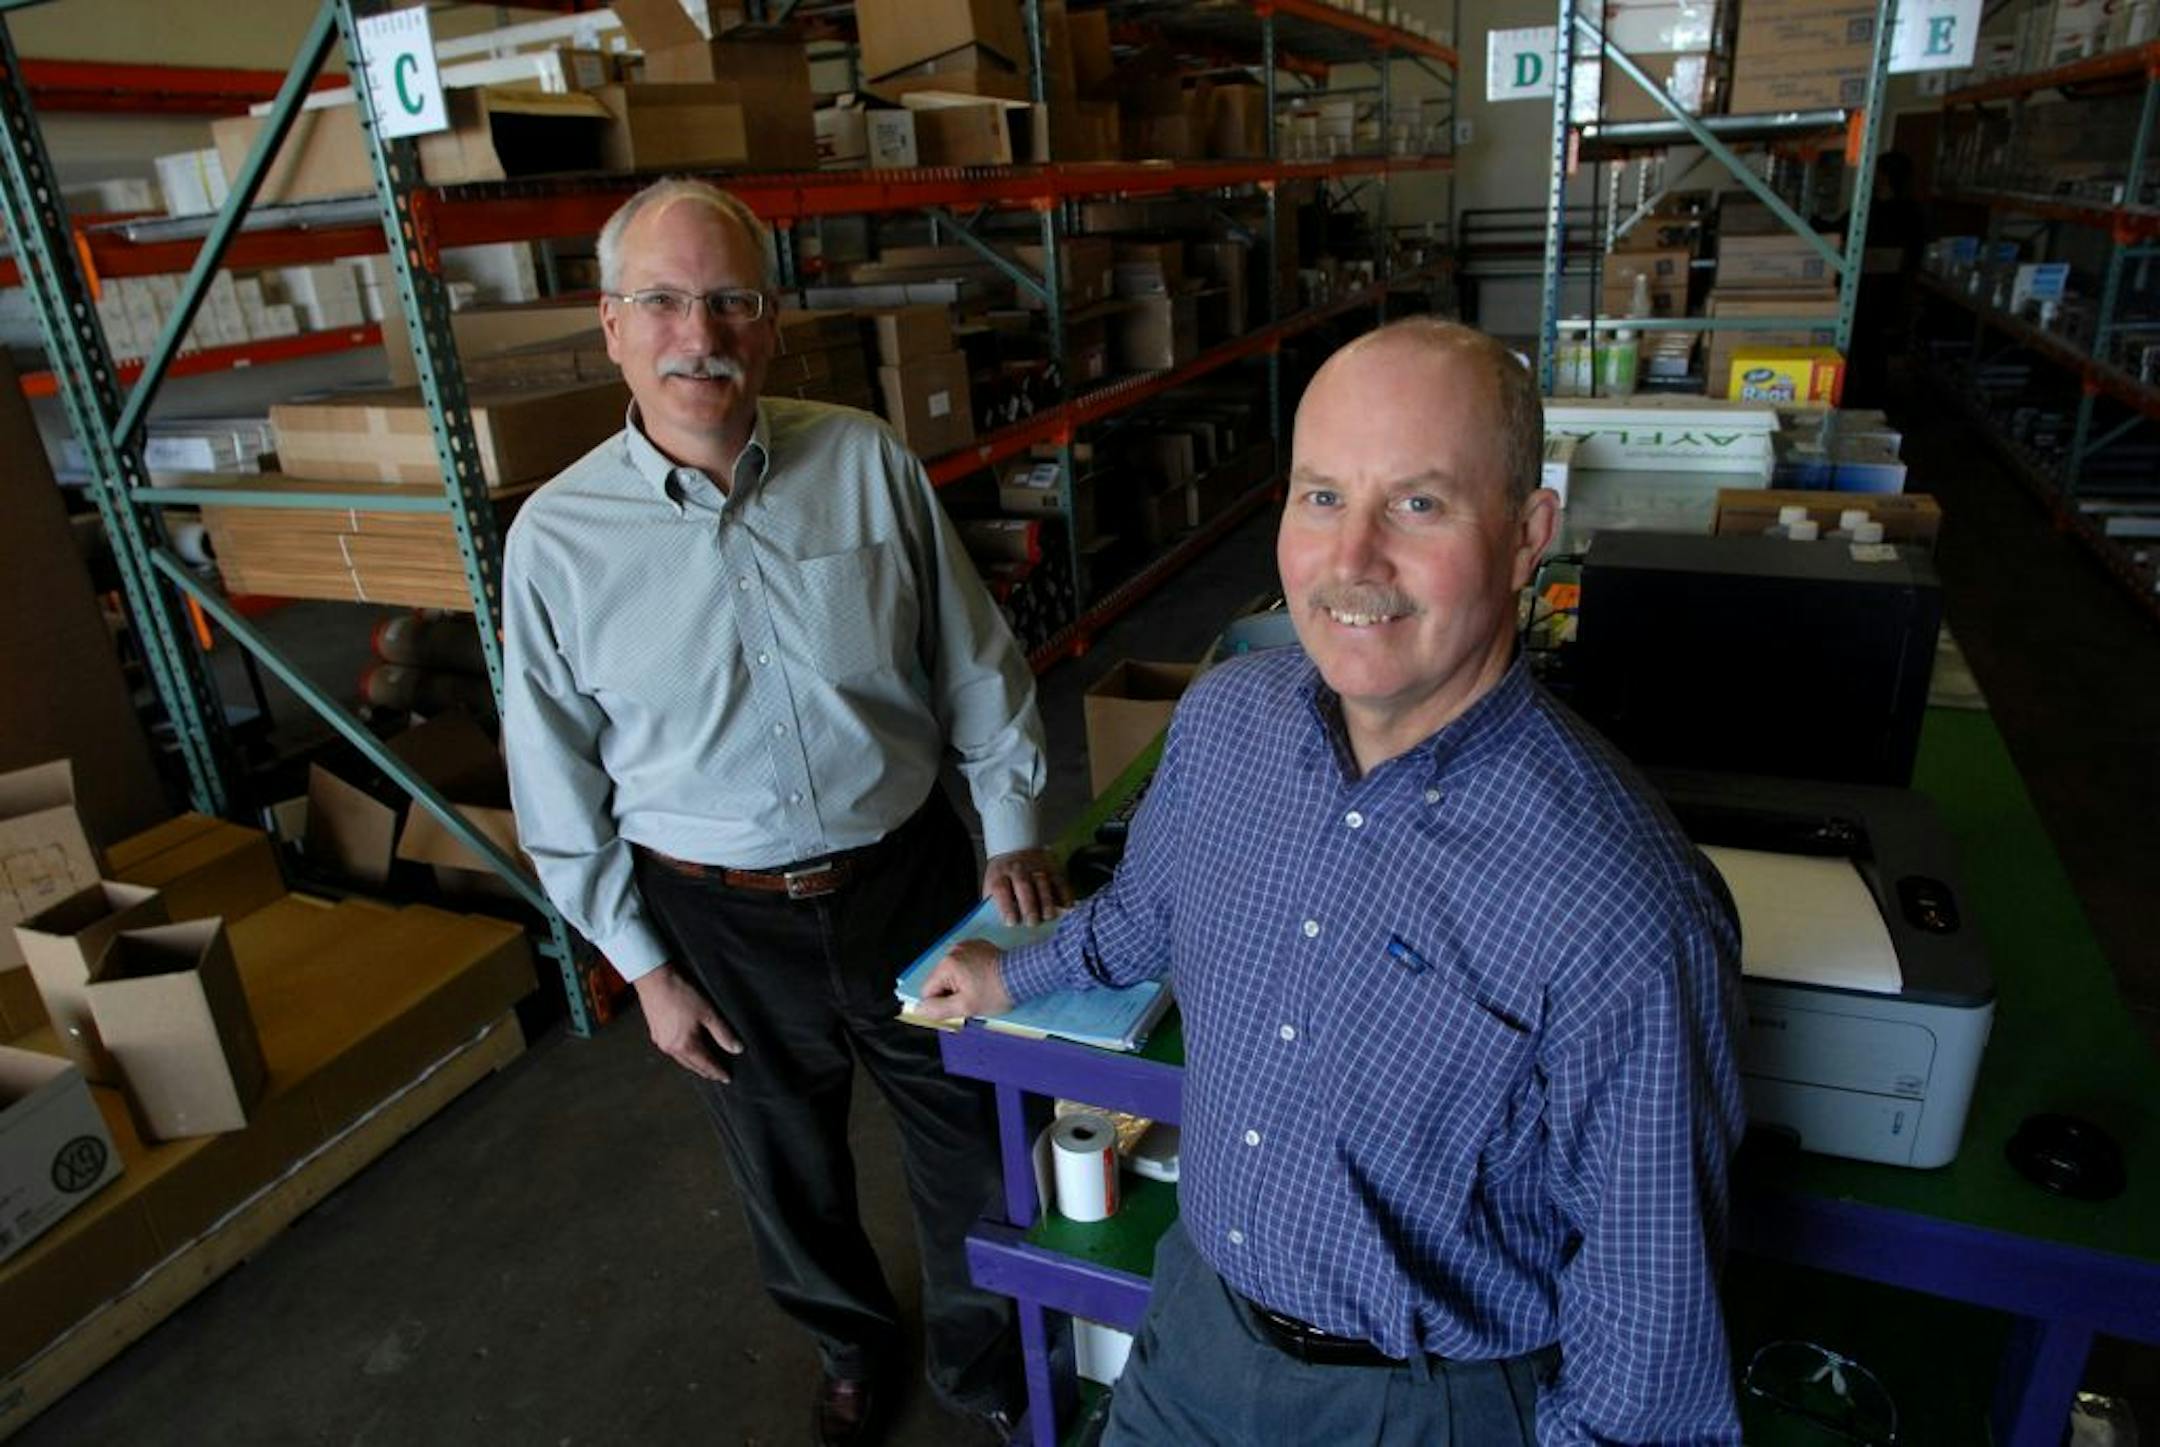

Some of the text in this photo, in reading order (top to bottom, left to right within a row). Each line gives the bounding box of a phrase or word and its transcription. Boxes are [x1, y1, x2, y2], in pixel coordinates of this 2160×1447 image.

[1924, 15, 1956, 57] E
[395, 52, 425, 116] C
[1513, 52, 1543, 87] D
